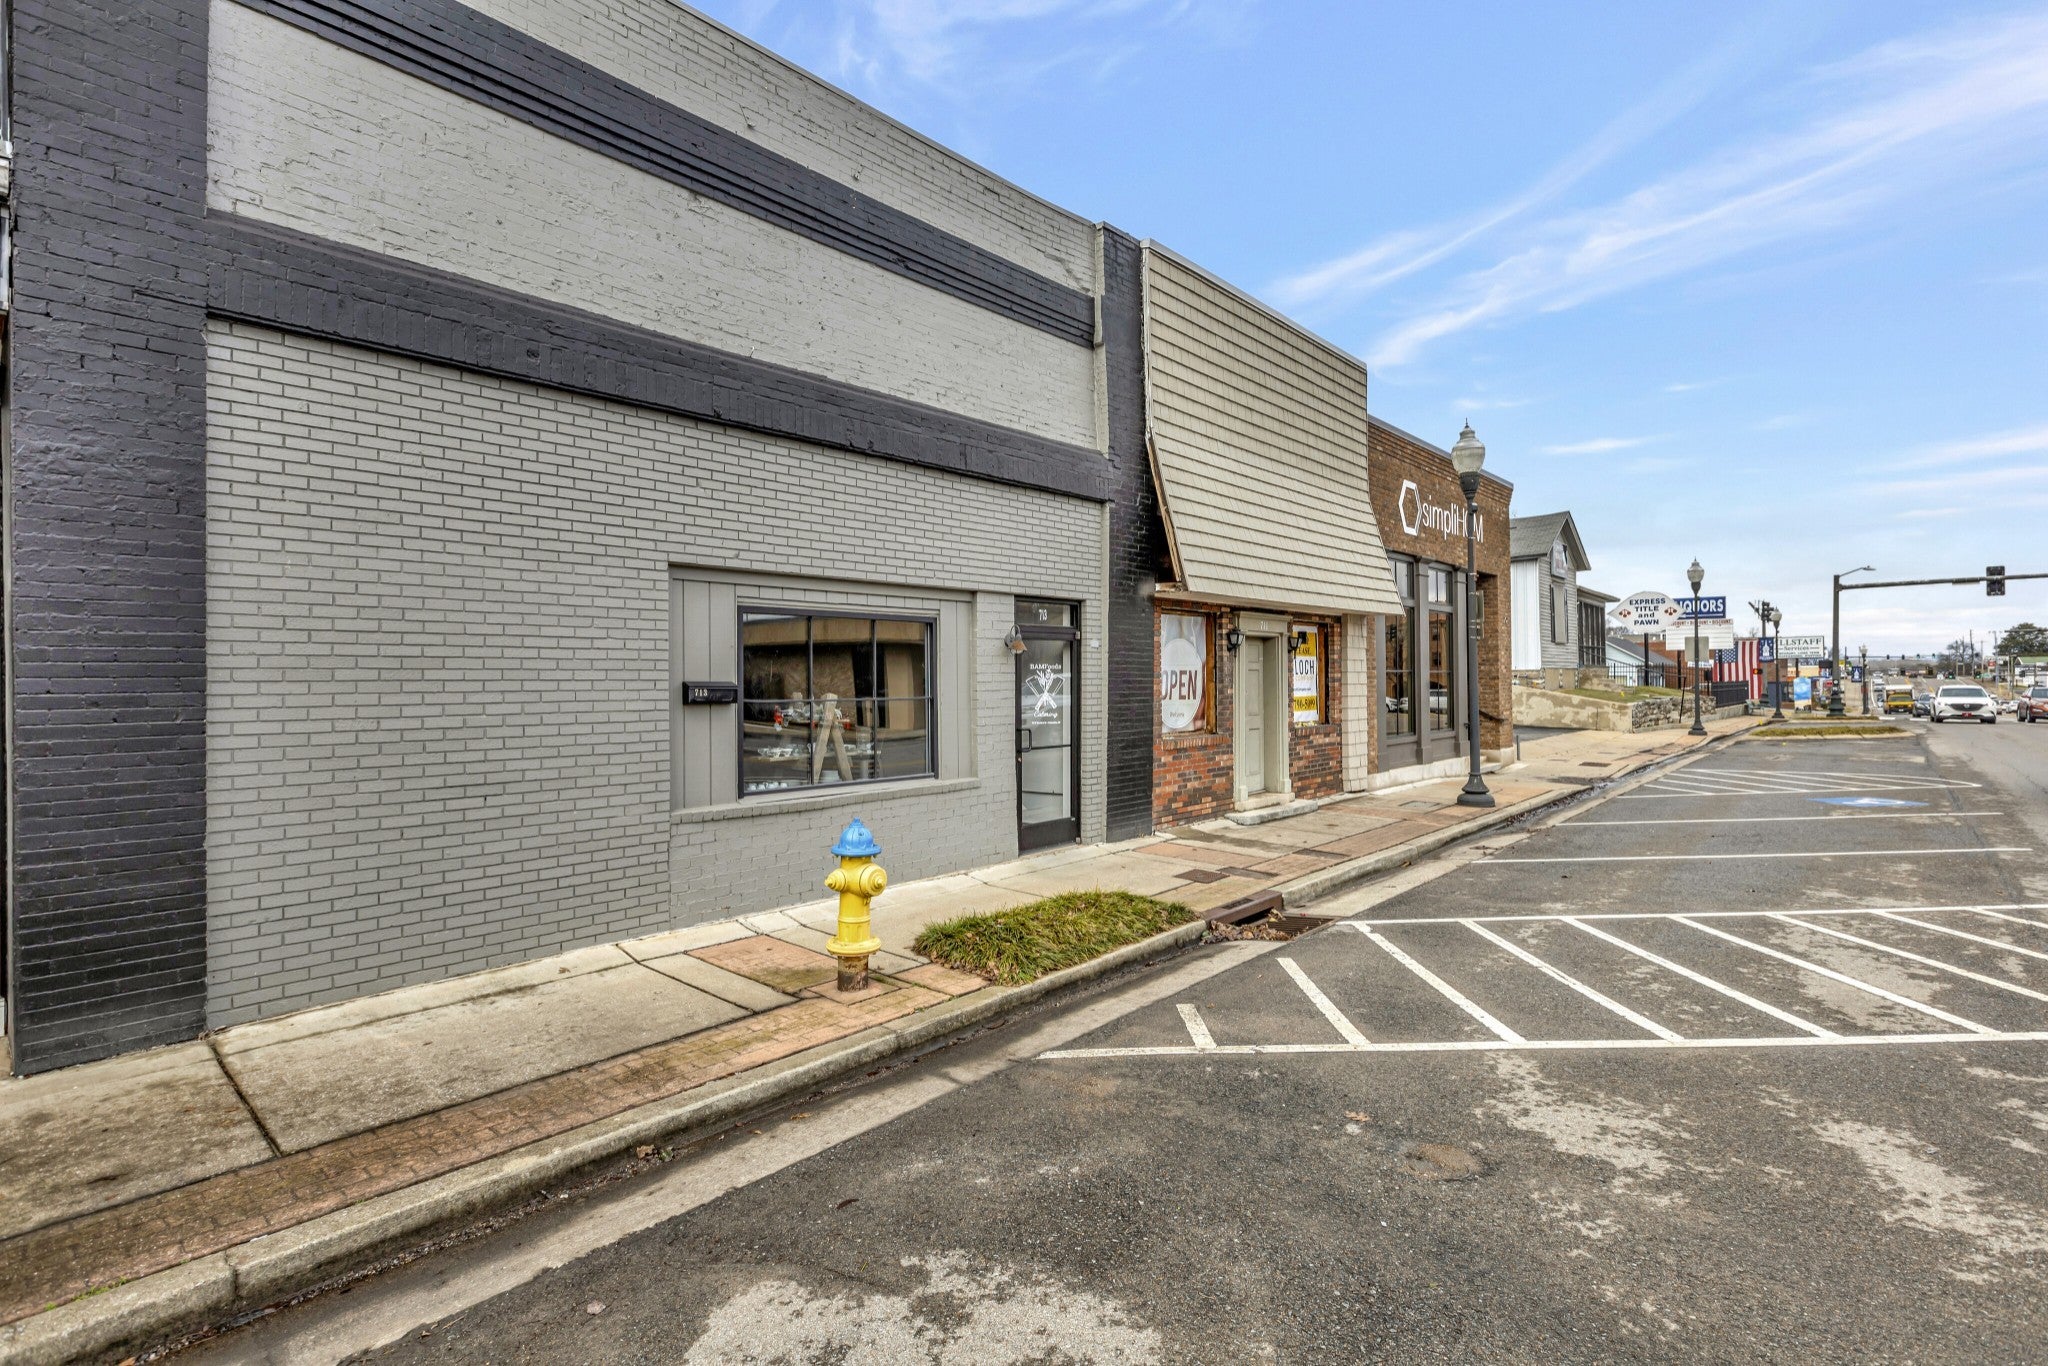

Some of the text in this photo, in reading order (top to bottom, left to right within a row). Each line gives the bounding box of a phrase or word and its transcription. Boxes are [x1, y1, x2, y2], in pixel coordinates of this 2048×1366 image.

[1680, 599, 1724, 613] IQUORS
[1038, 608, 1048, 621] 713
[1161, 669, 1198, 701] OPEN
[694, 688, 708, 697] 713
